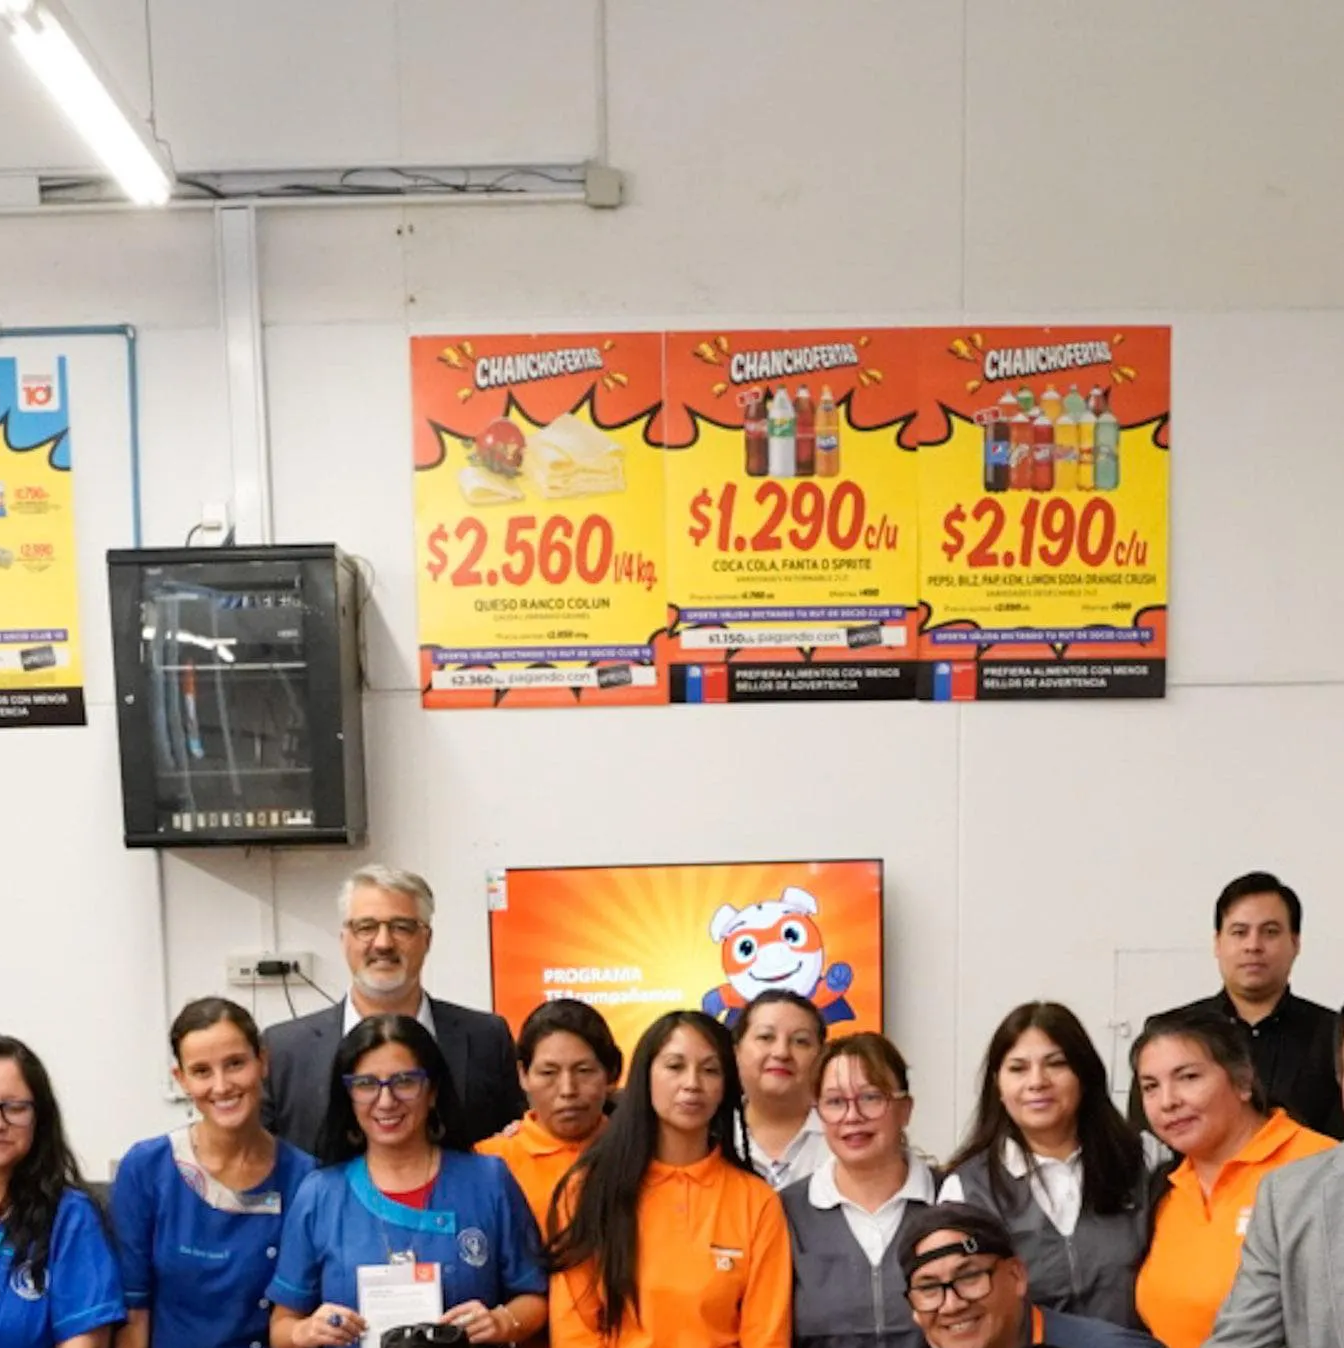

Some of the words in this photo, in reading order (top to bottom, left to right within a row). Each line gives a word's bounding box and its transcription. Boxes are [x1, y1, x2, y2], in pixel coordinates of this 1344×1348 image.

[475, 348, 603, 389] CHANCHOFERTAS
[730, 343, 858, 384] CHANCHOFERTAS
[984, 340, 1112, 380] CHANCHOFERTAS
[688, 480, 866, 552] $1.290
[942, 497, 1116, 568] $2.190
[426, 514, 614, 587] $2.560
[712, 559, 744, 573] COCA
[782, 558, 818, 570] FANTA
[832, 558, 872, 570] SPRITE
[474, 599, 518, 612] QUESO
[568, 597, 610, 609] COLUN
[543, 967, 643, 984] PROGRAMA
